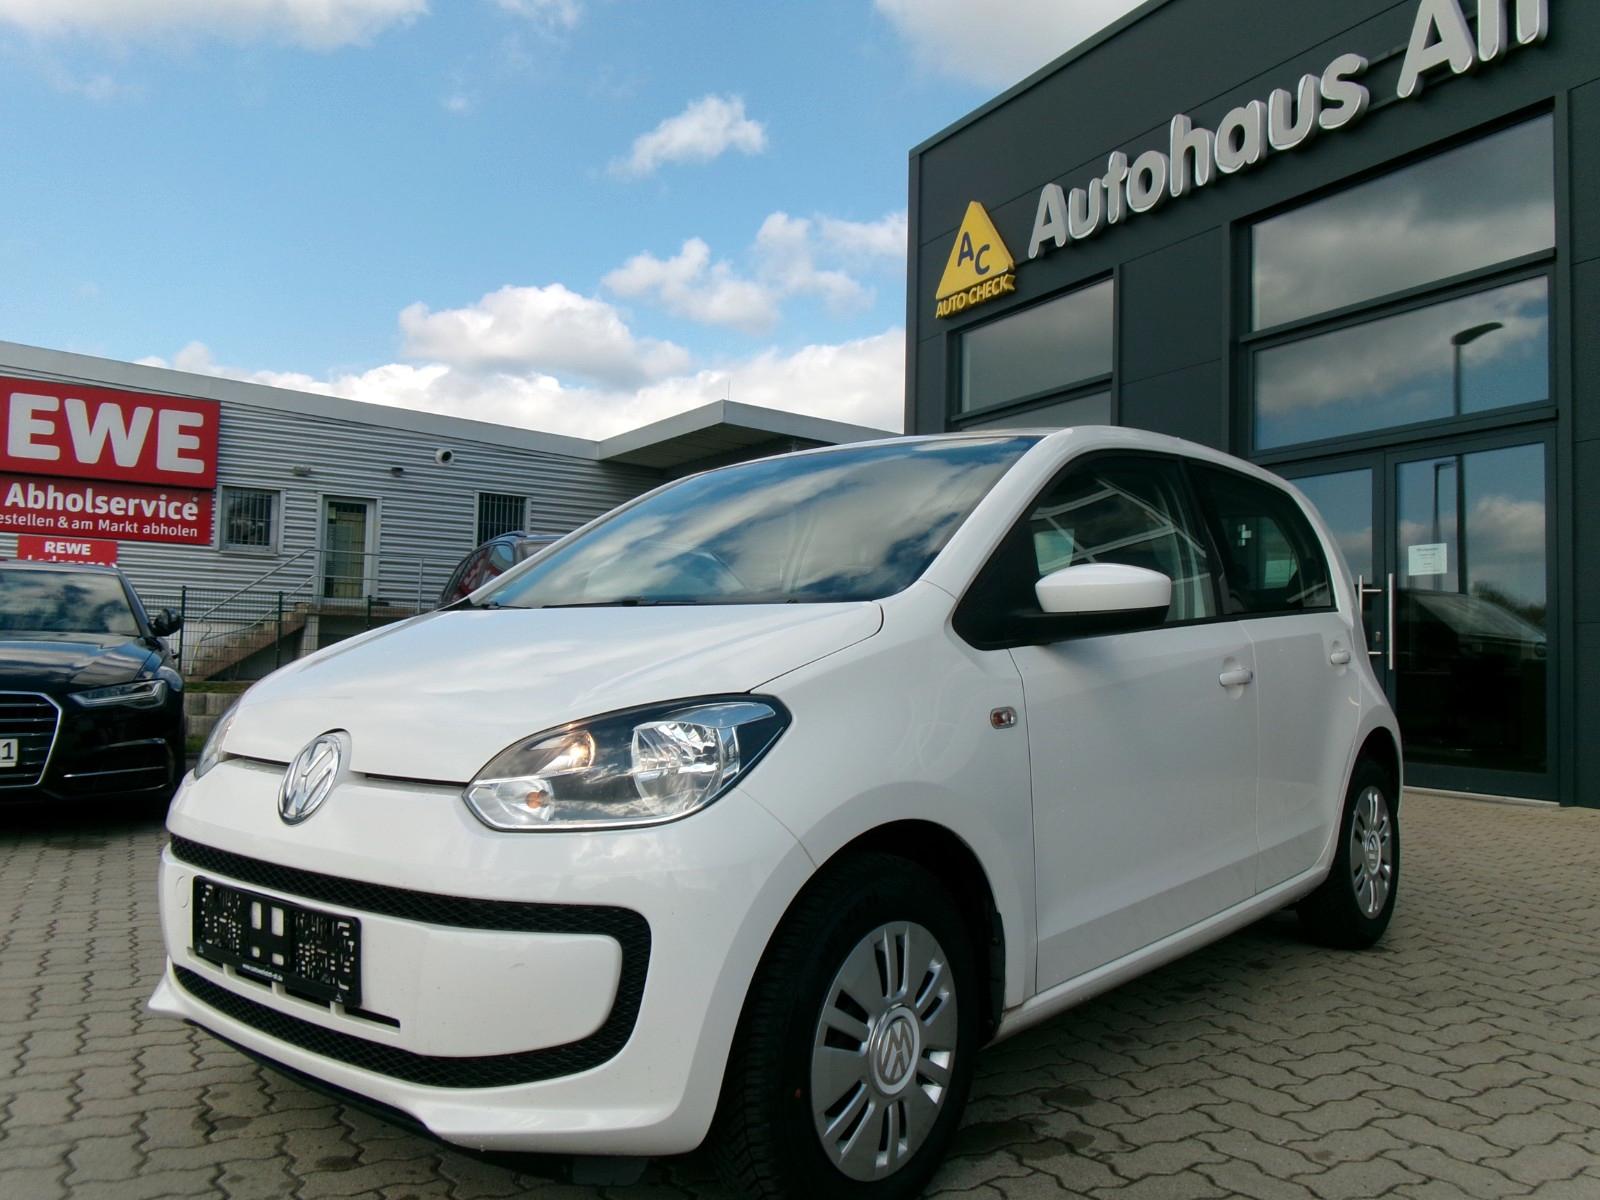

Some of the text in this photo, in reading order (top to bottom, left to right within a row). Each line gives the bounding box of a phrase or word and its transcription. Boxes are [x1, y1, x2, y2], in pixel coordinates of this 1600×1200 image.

[1028, 53, 1369, 259] Autohaus
[957, 231, 990, 275] AC
[935, 273, 1015, 319] AUTO CHECK
[7, 392, 205, 474] EWE
[4, 482, 199, 521] Abholservice
[44, 540, 91, 556] REWE
[57, 515, 69, 529] &
[71, 518, 94, 530] am
[98, 518, 139, 534] Markt
[142, 521, 198, 537] abholen
